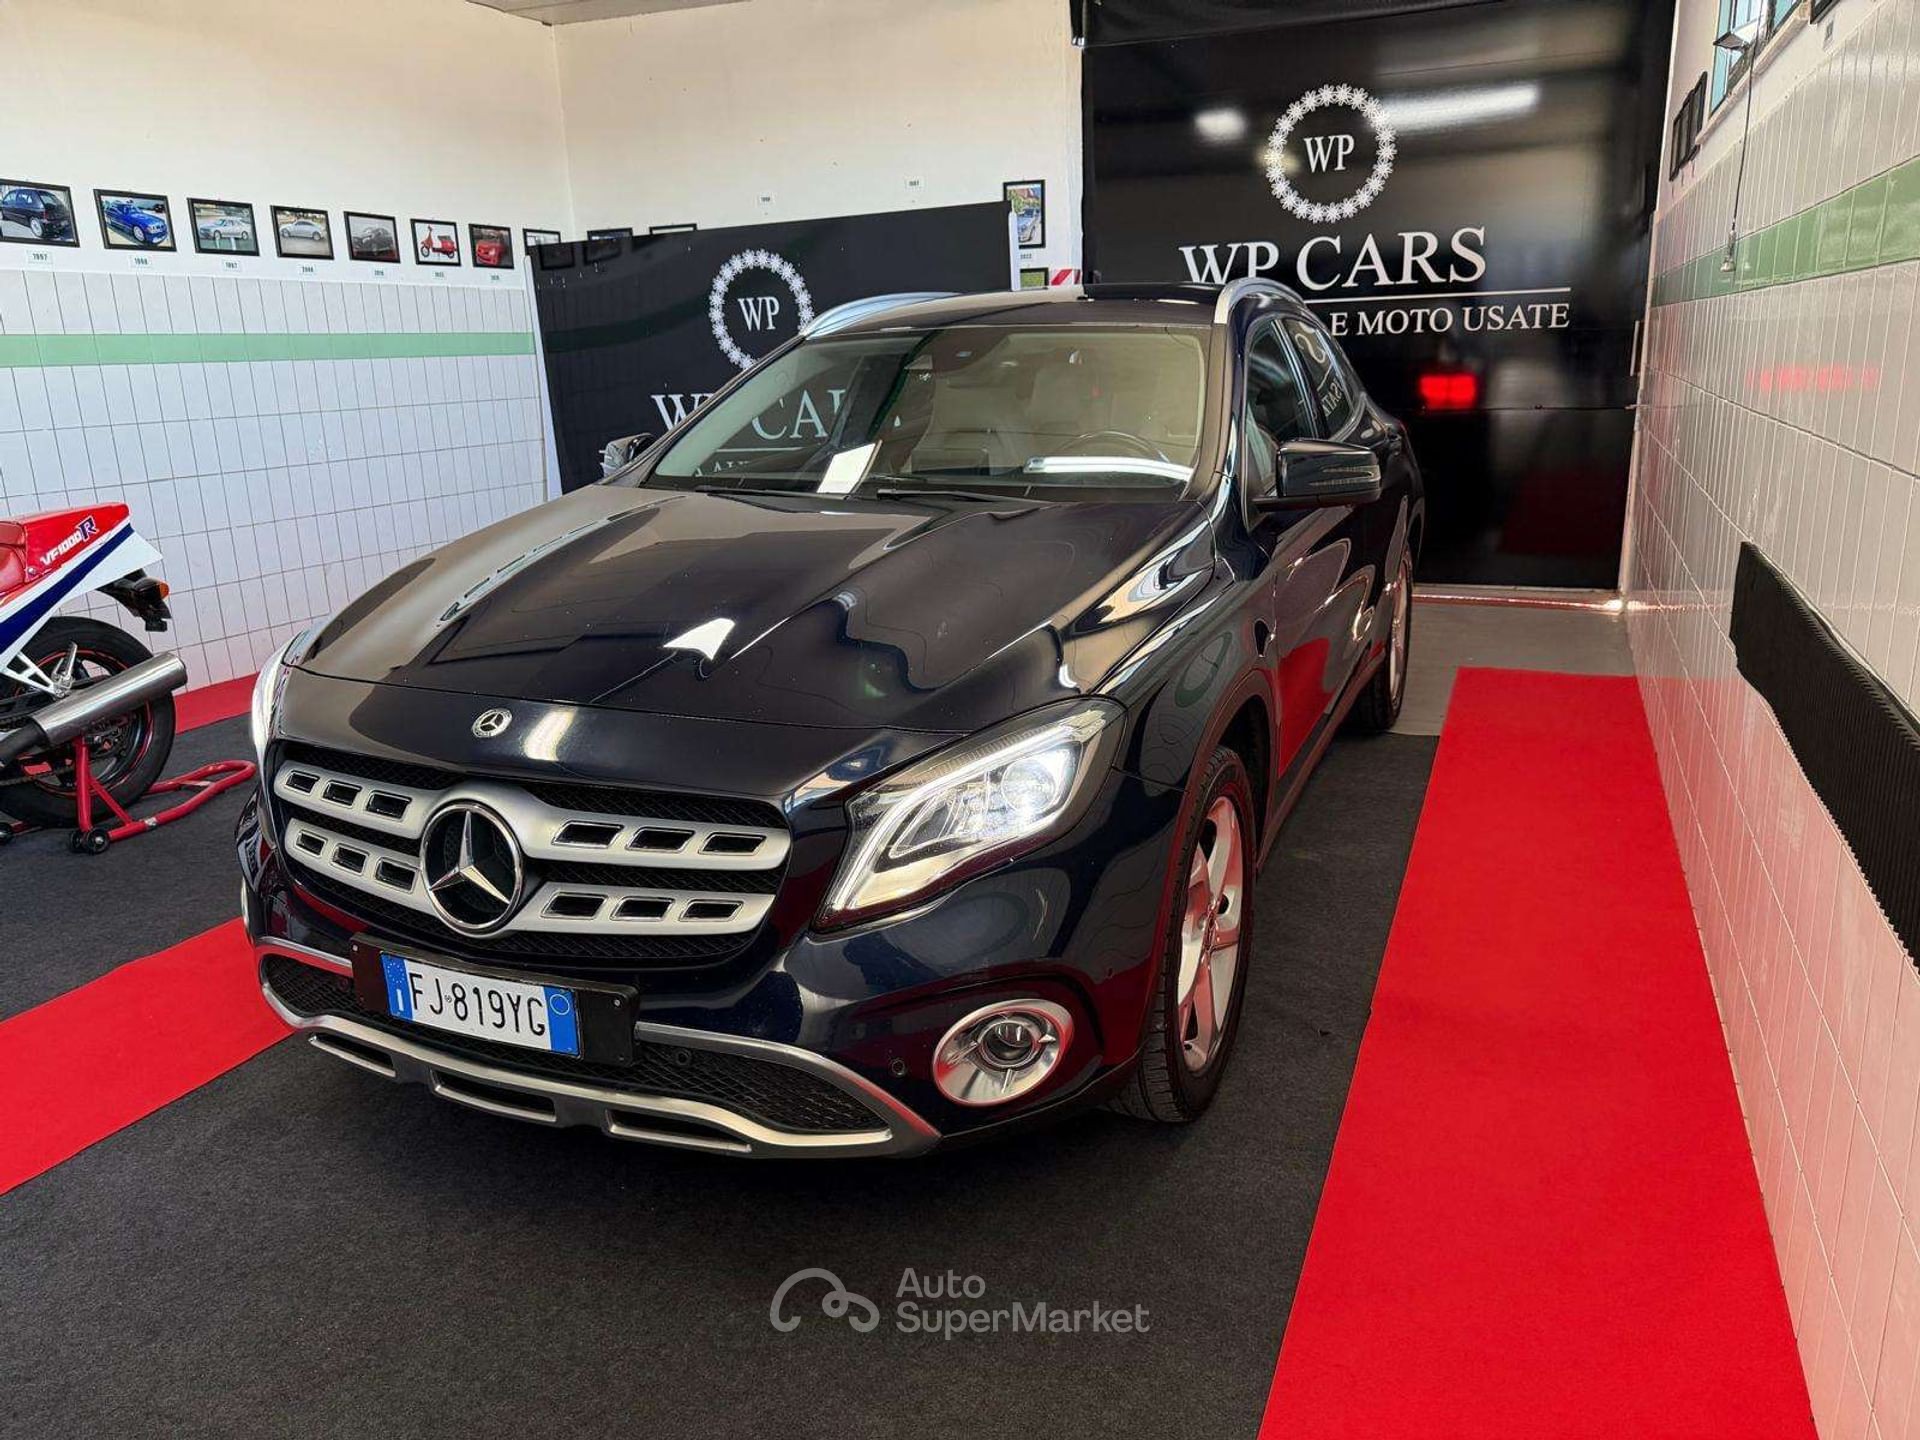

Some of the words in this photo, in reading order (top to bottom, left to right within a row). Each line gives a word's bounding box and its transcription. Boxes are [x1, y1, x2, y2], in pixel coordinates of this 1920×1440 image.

[1303, 134, 1355, 173] WP
[1179, 241, 1280, 285] WP
[1296, 226, 1487, 291] CARS
[737, 296, 780, 331] WP
[1329, 312, 1349, 336] E
[1355, 306, 1455, 336] MOTO
[1463, 303, 1571, 332] USATE
[651, 393, 716, 432] W
[40, 515, 99, 565] VF1000R
[408, 972, 546, 1037] FJ819YG
